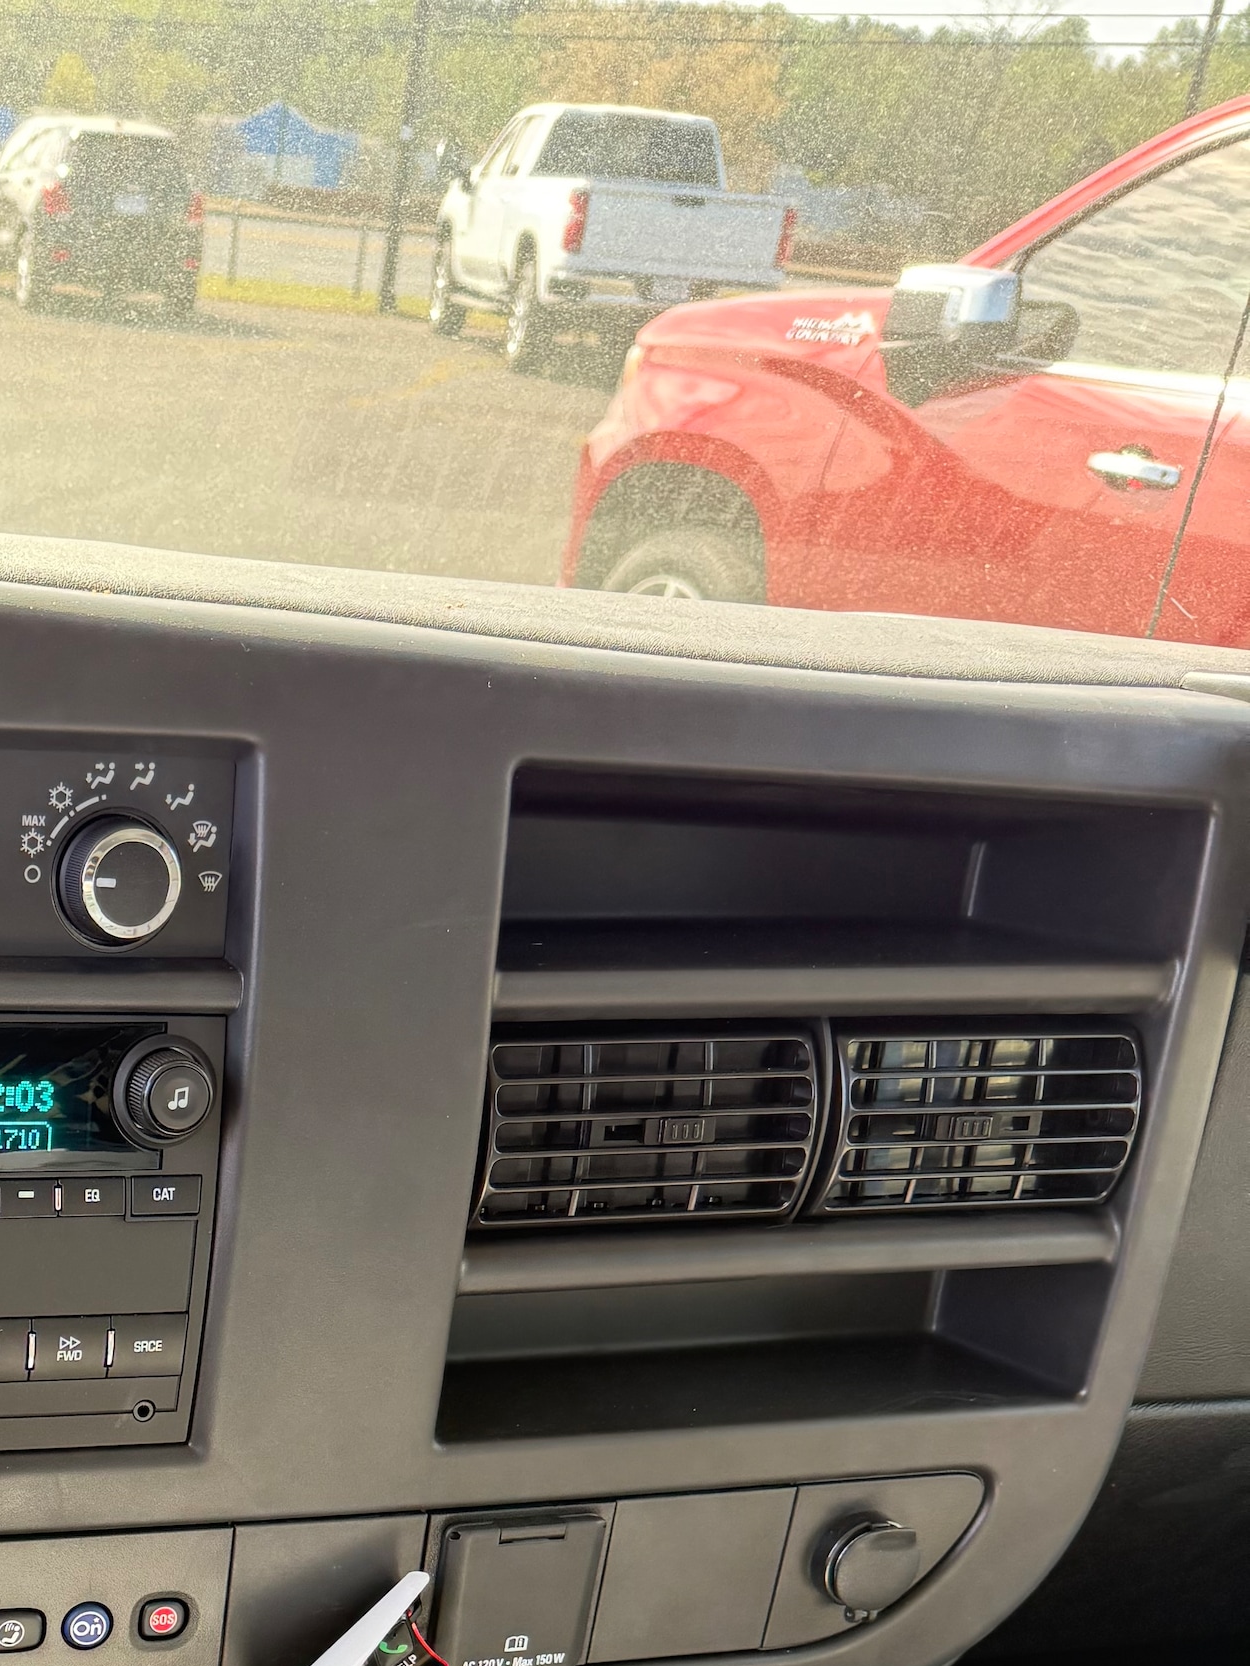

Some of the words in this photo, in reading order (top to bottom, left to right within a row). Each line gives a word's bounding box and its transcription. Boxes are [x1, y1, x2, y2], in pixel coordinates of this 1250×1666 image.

[22, 815, 46, 827] MAX
[84, 1189, 100, 1202] EQ
[152, 1187, 176, 1201] CAT
[133, 1340, 162, 1353] SRCE
[56, 1350, 82, 1361] FWD
[152, 1614, 175, 1626] SOS
